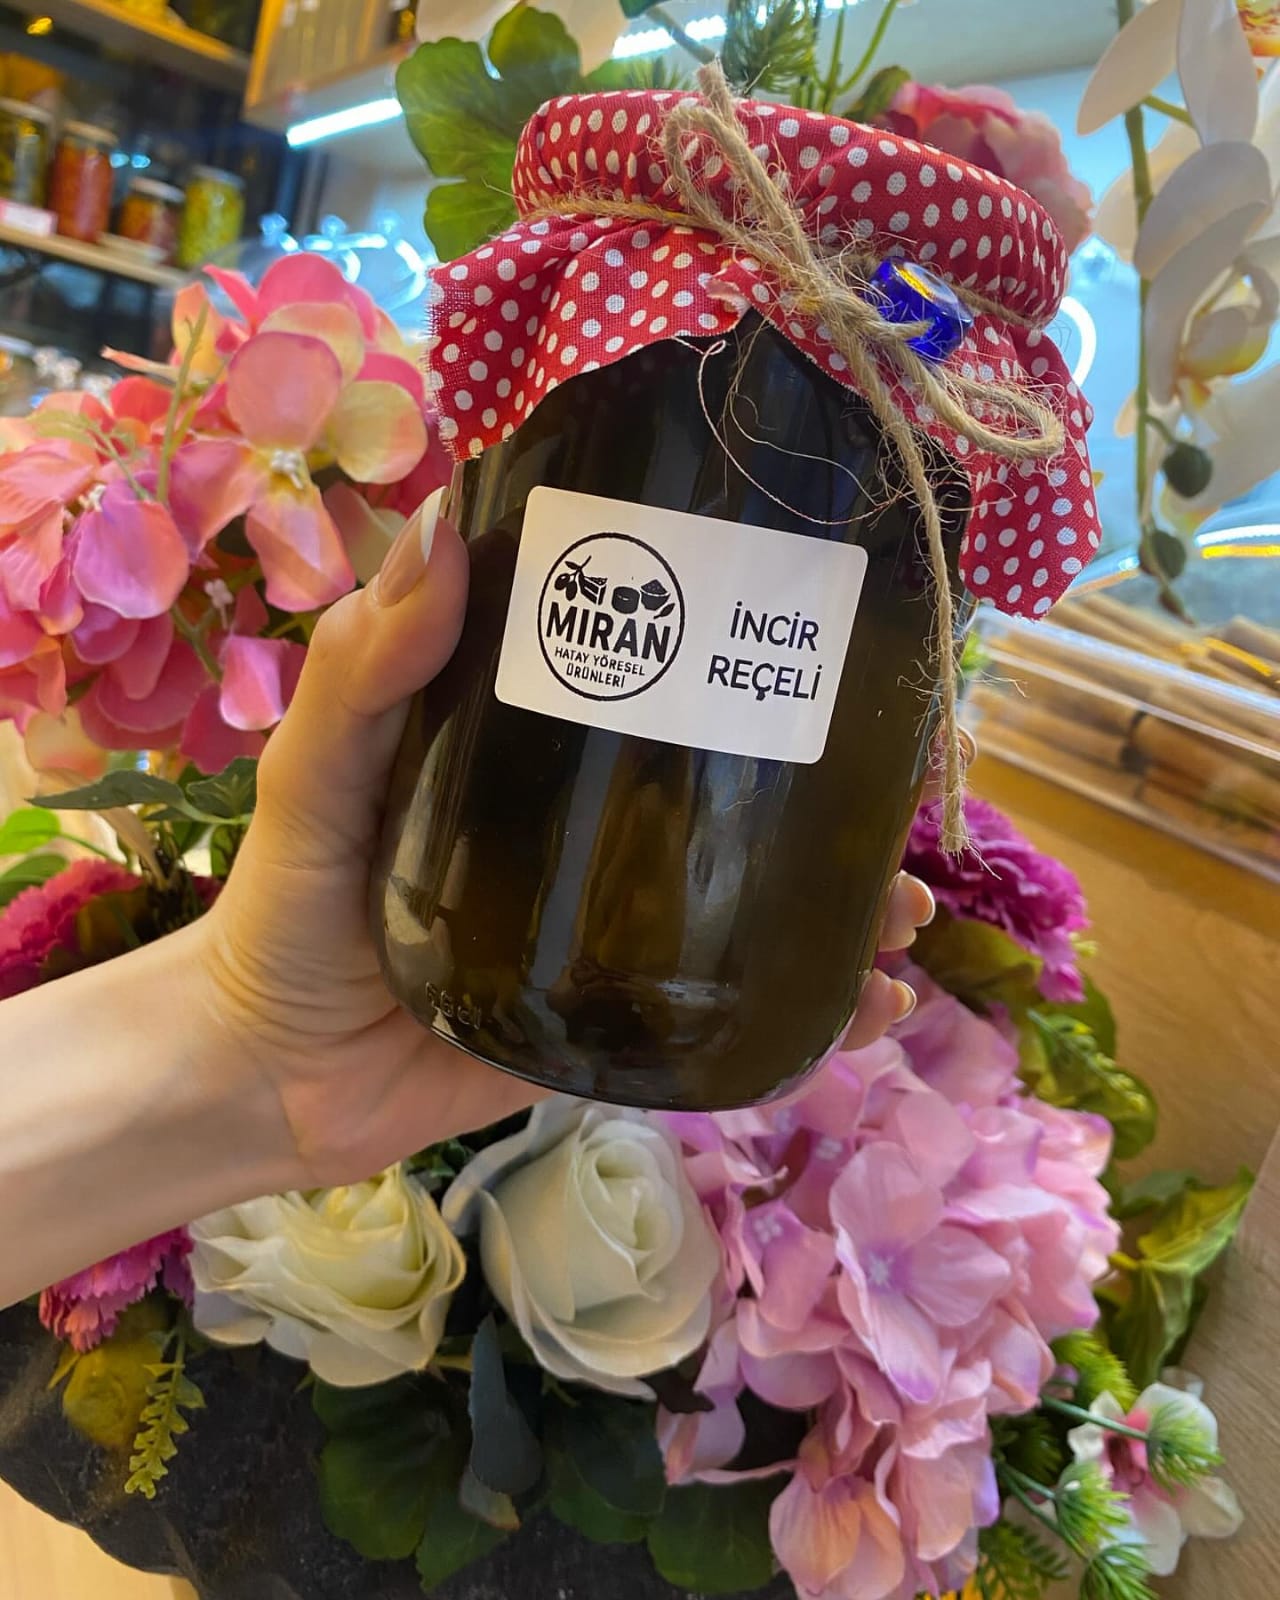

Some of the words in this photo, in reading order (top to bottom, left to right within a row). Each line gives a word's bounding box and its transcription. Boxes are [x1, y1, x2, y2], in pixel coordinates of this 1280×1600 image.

[546, 602, 671, 663] MIRAN
[730, 601, 819, 651] İNCİR
[554, 646, 590, 664] HATAY
[593, 652, 645, 676] YÖRESEL
[566, 666, 626, 688] ÜRÜNLERİ
[707, 655, 823, 701] REÇELİ
